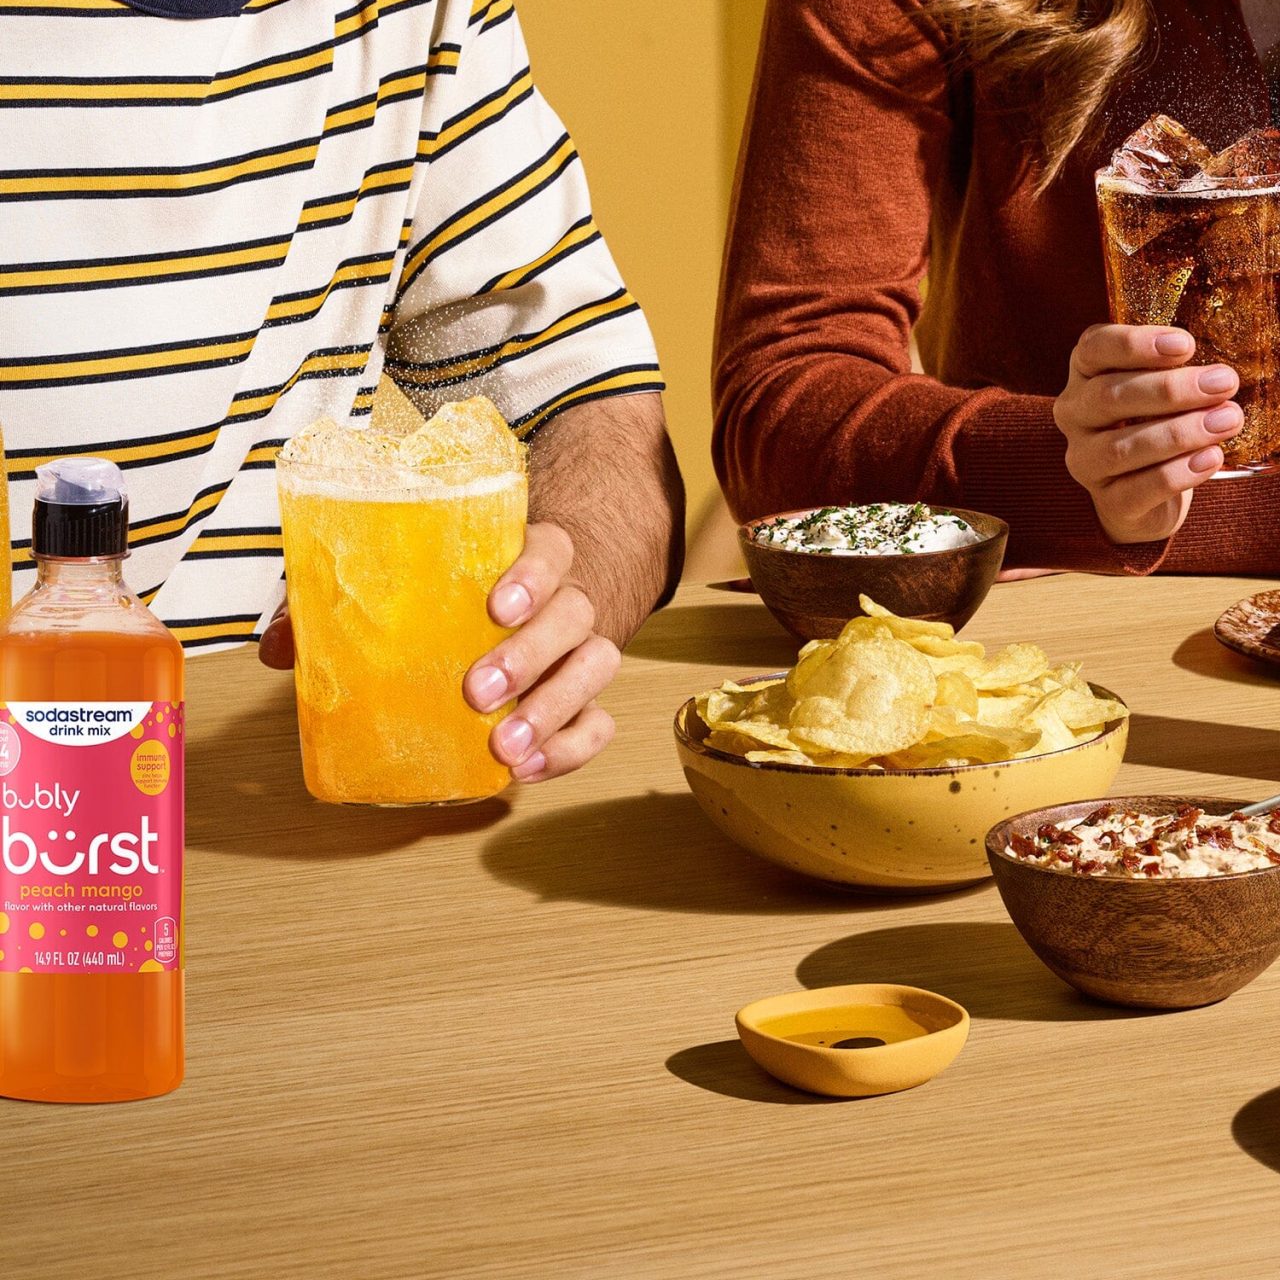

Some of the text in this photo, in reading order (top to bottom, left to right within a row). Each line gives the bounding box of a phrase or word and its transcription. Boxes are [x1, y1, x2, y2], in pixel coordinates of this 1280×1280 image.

[26, 708, 132, 722] sodastream
[49, 725, 111, 736] drink mix
[136, 762, 167, 772] support
[3, 782, 80, 817] bubly
[20, 883, 143, 901] peach mango
[4, 902, 158, 912] flavor with other natural flavors
[53, 952, 64, 966] FL
[67, 952, 80, 966] OZ
[82, 951, 104, 967] (440
[107, 951, 125, 967] mL)
